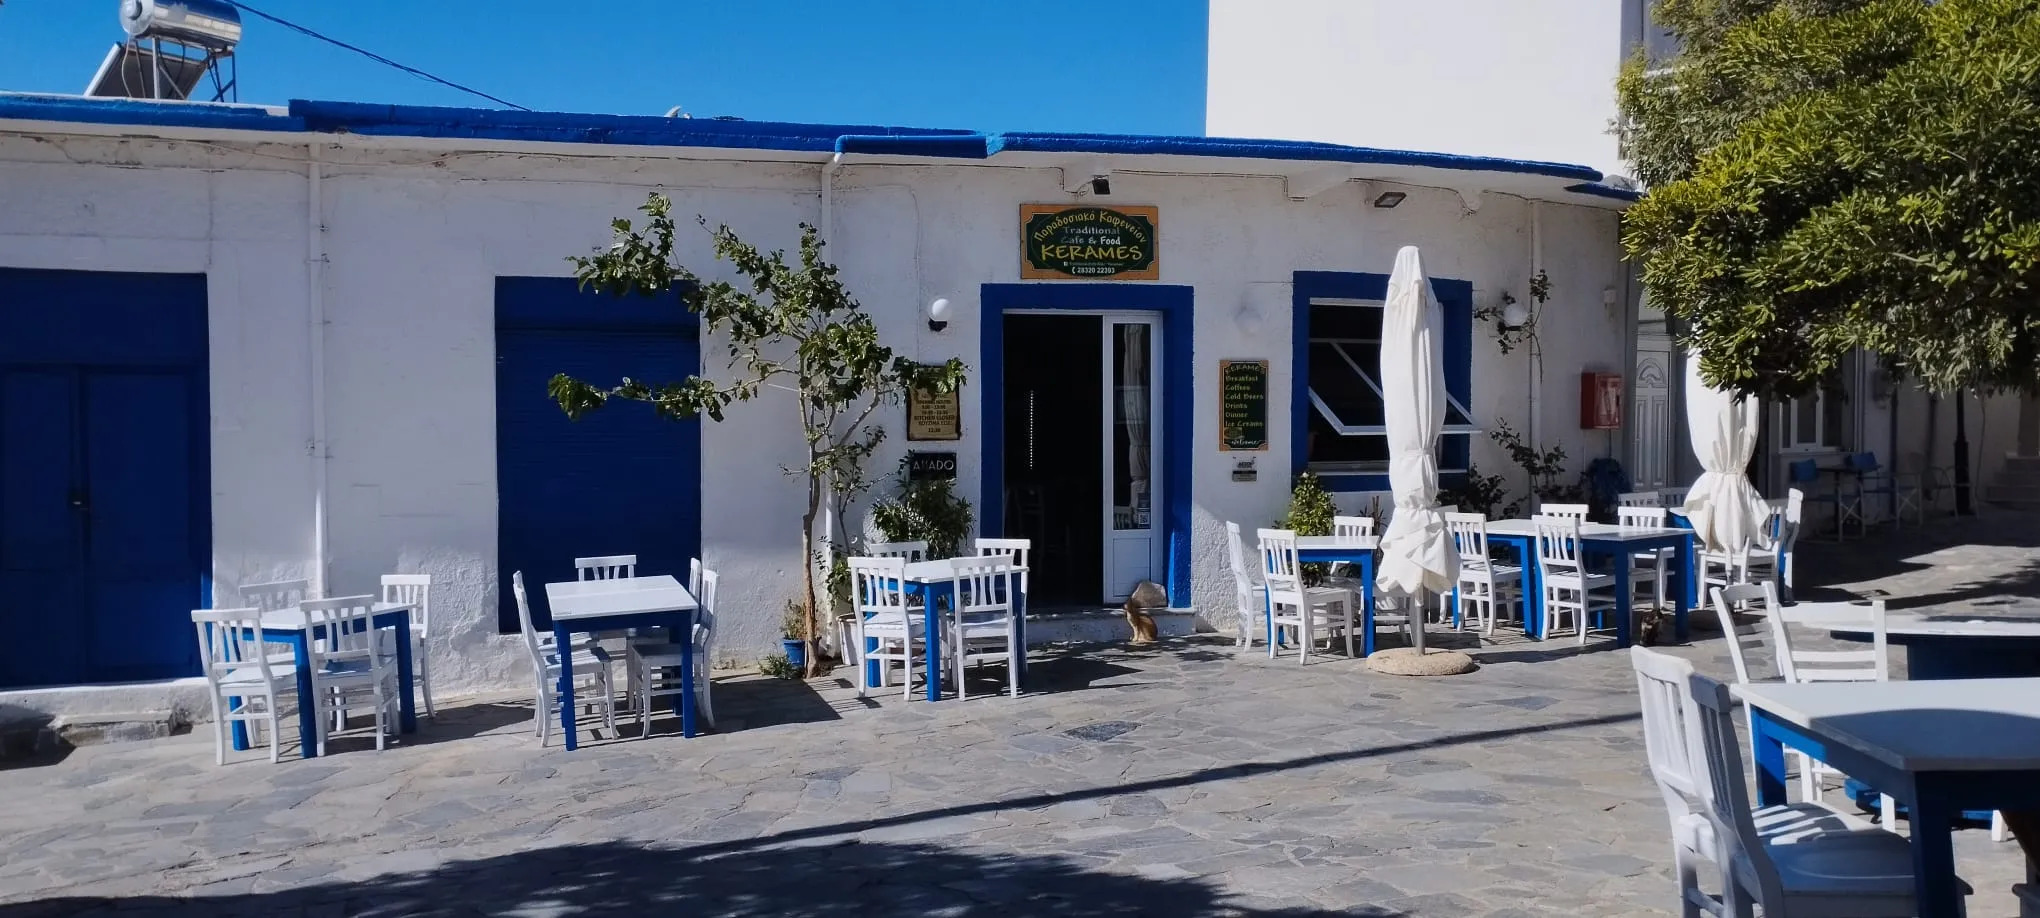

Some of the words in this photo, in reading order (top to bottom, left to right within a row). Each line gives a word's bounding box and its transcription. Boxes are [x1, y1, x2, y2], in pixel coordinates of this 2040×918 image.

[1034, 210, 1096, 241] Παραδοσιακό
[1099, 210, 1148, 243] Καφενείον
[1063, 226, 1121, 235] Traditional
[1088, 236, 1098, 244] &
[1100, 236, 1121, 245] Food
[1041, 244, 1142, 260] KERAMES
